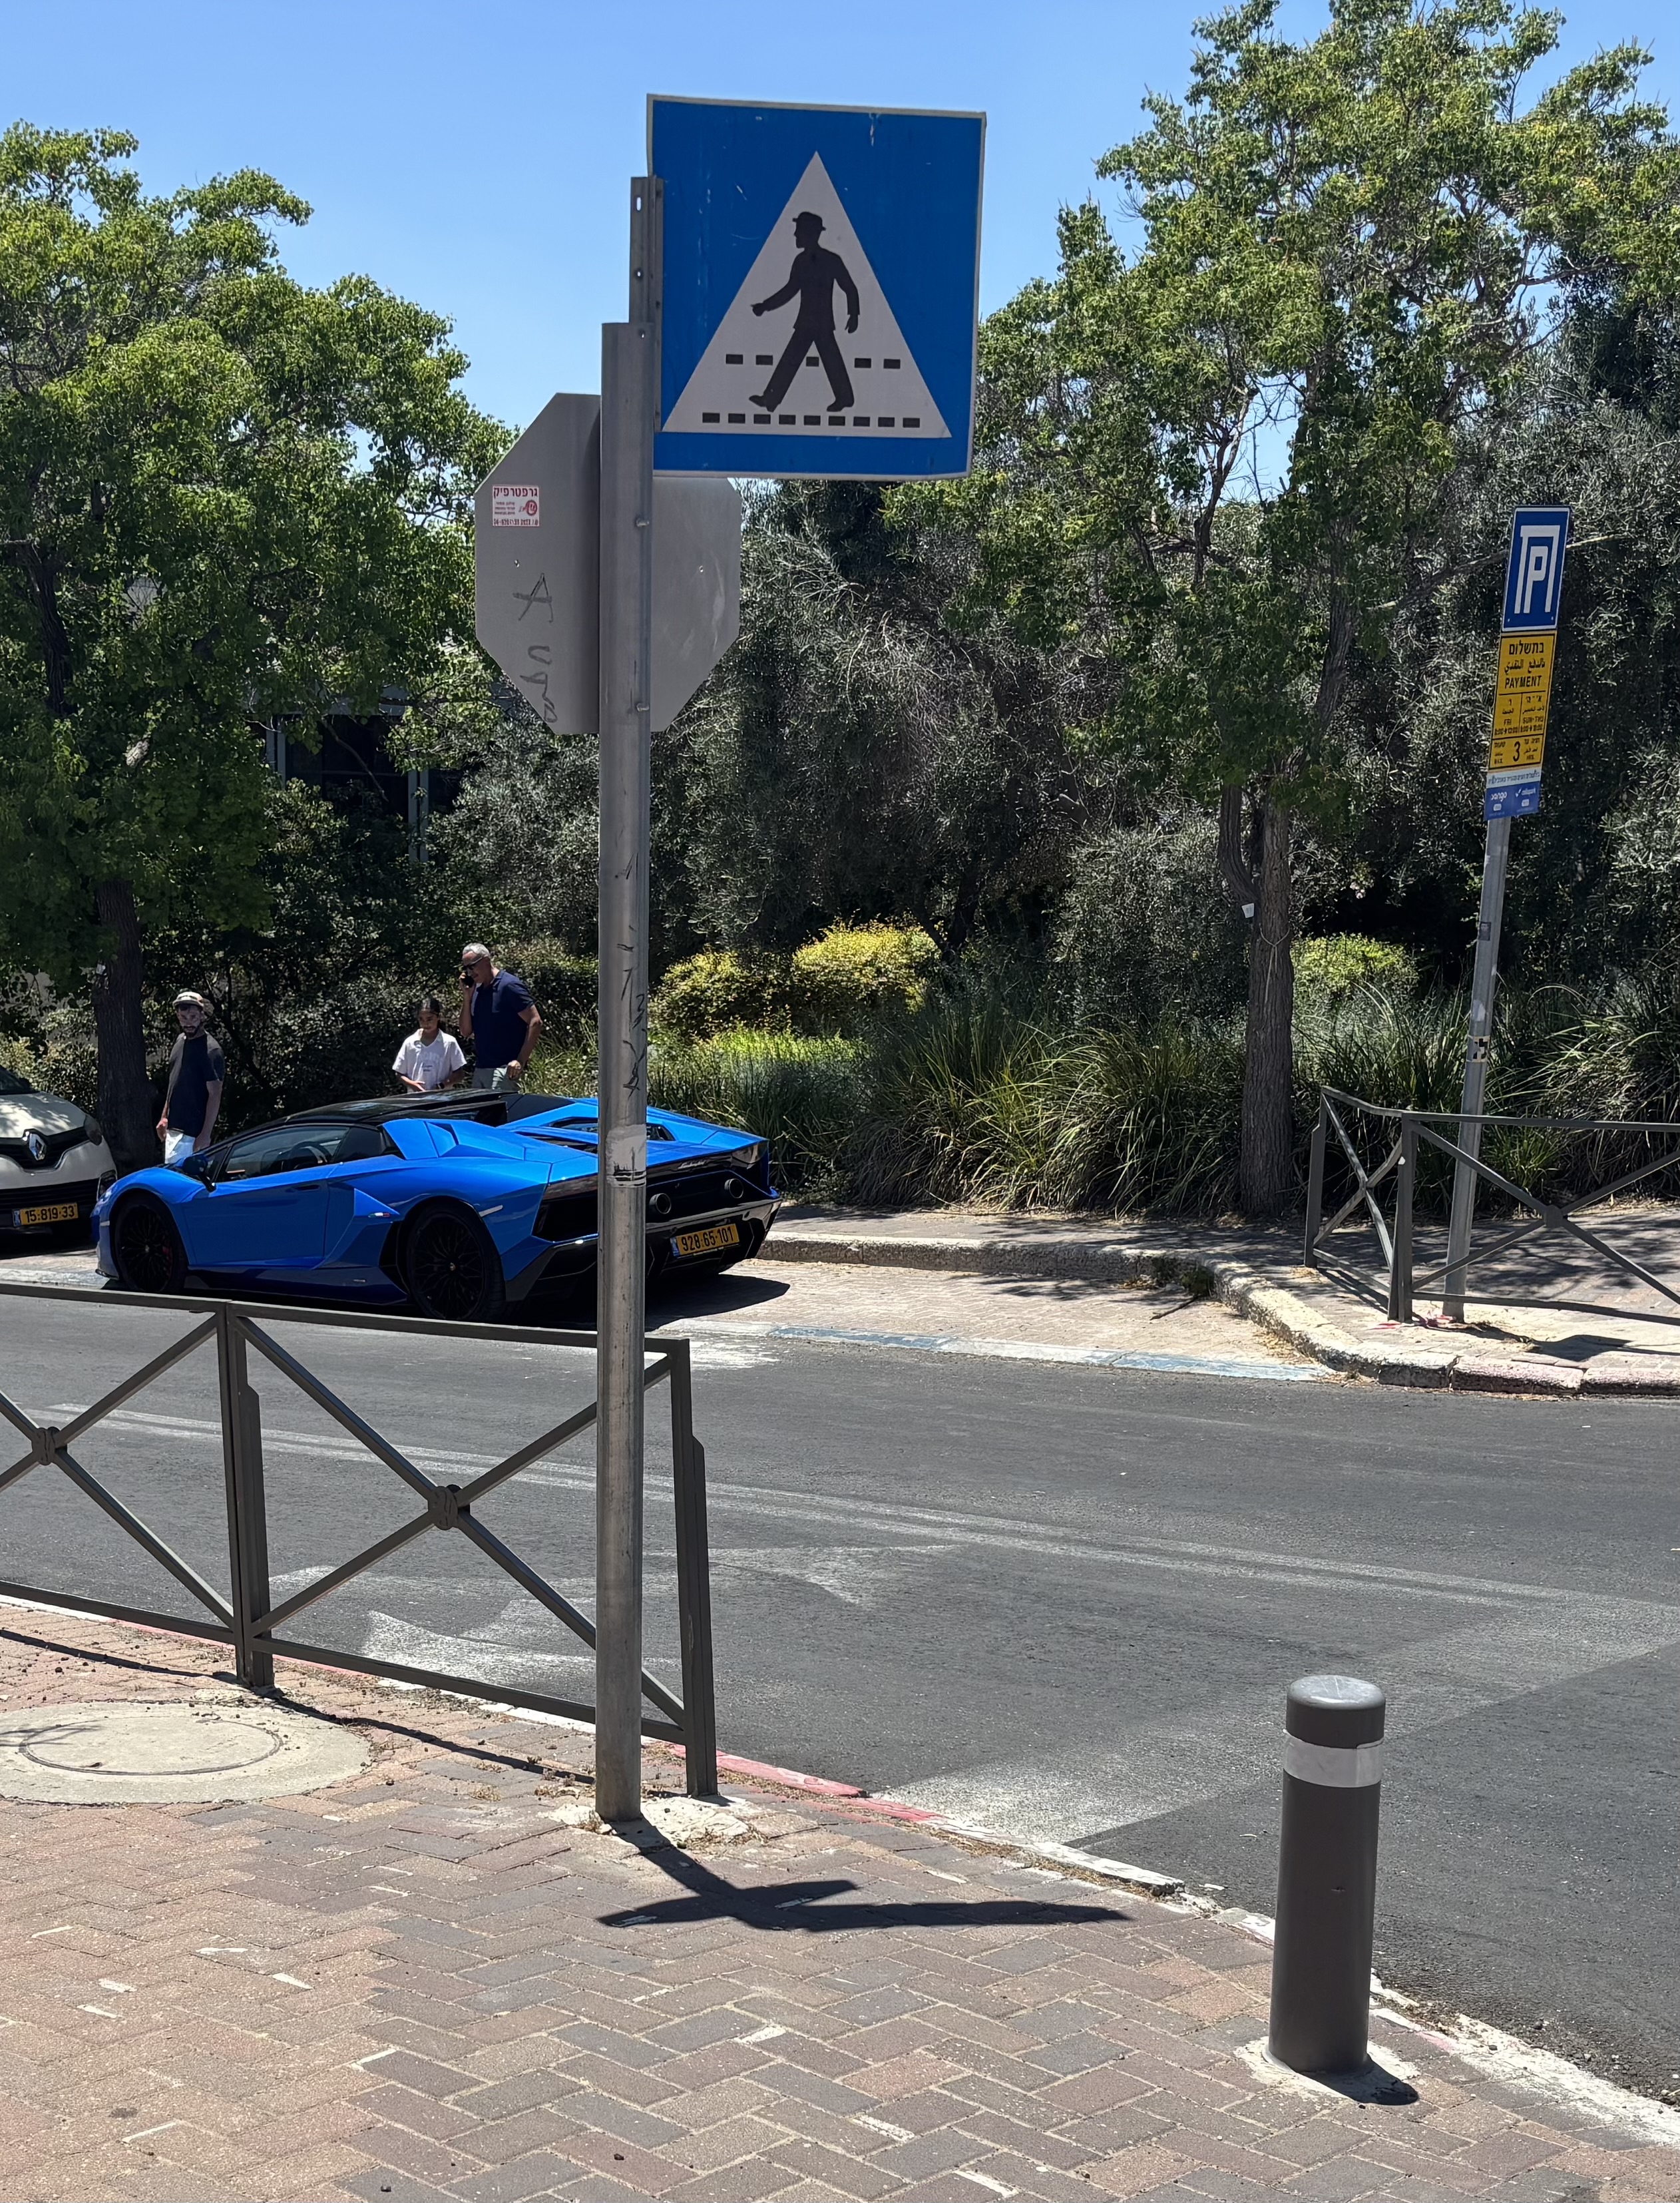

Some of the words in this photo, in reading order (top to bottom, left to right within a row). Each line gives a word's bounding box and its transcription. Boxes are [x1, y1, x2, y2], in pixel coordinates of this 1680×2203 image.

[493, 487, 538, 499] גרפטרפיק
[1509, 640, 1544, 655] בתשלום
[1505, 675, 1542, 689] PAYMENT
[1513, 741, 1521, 762] 3
